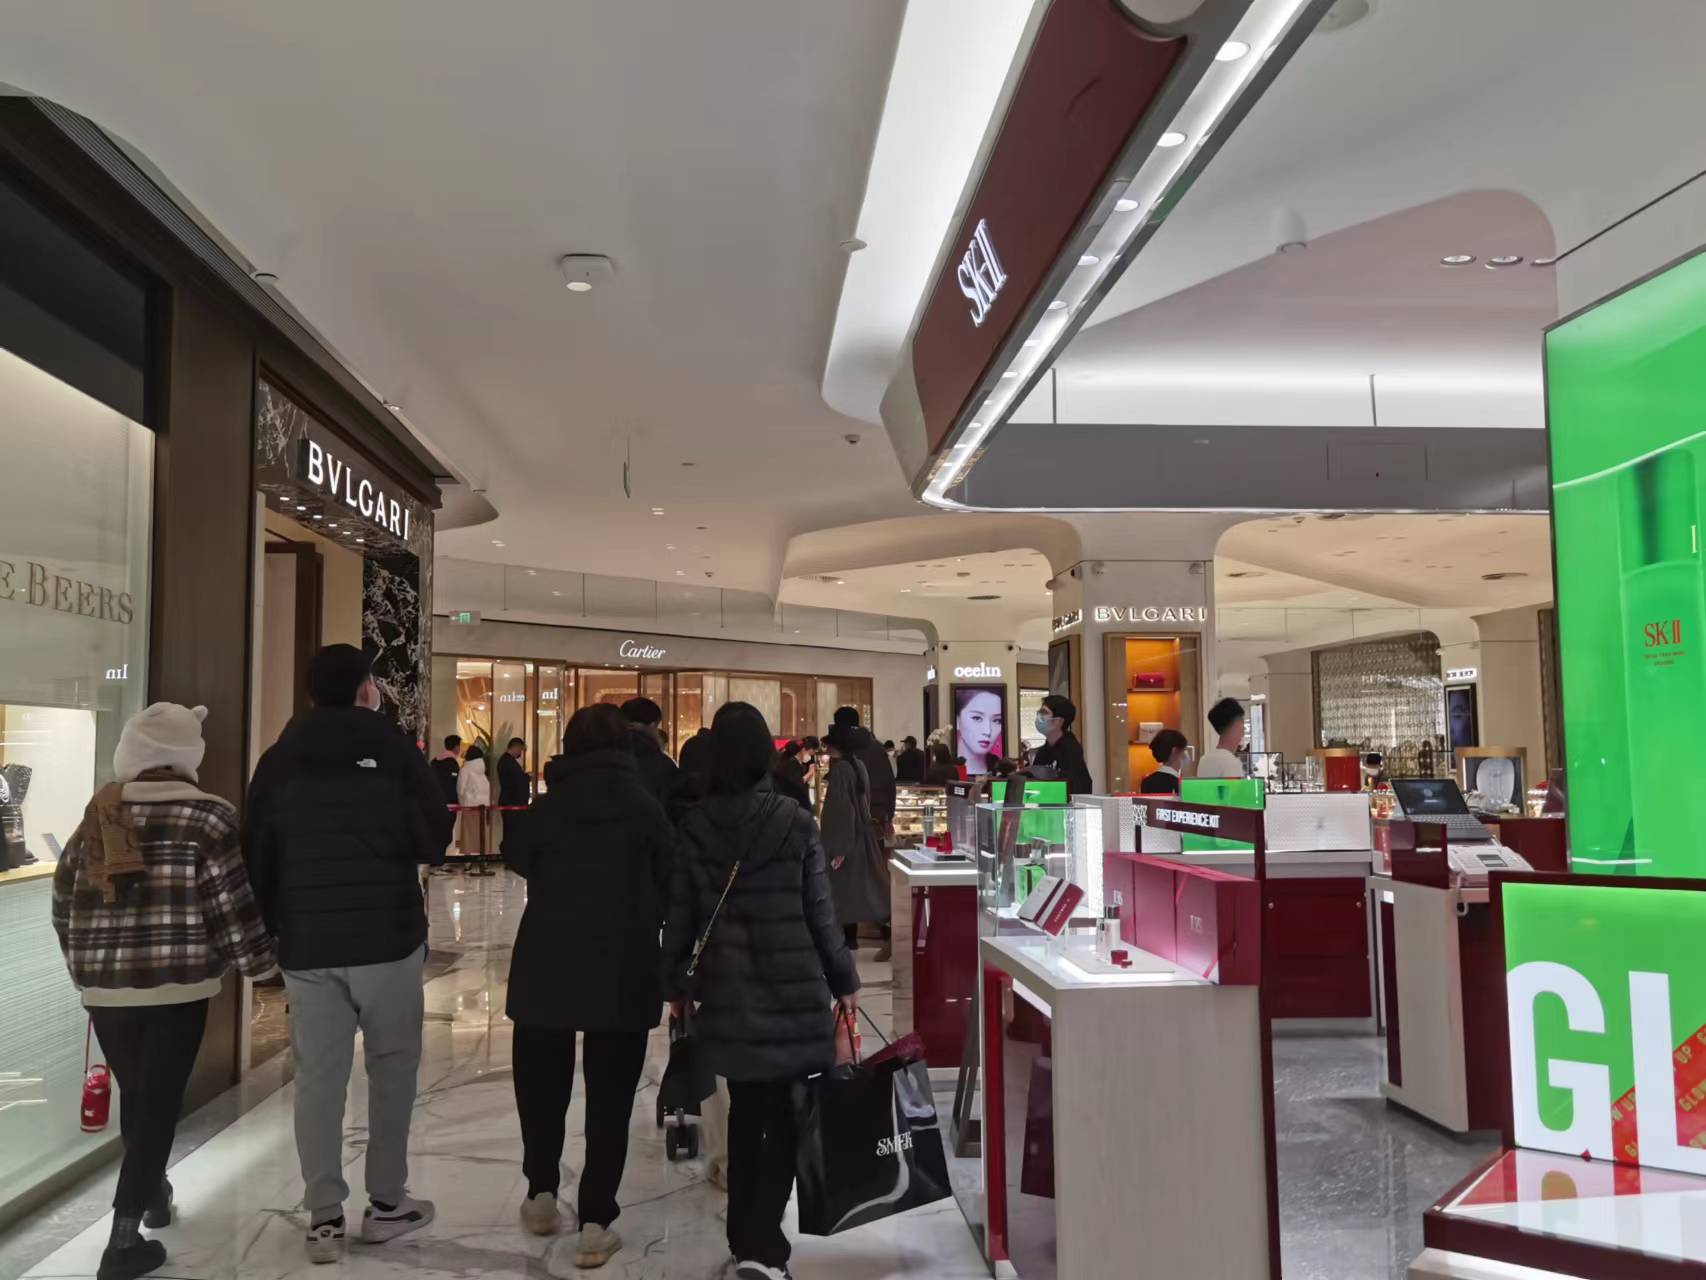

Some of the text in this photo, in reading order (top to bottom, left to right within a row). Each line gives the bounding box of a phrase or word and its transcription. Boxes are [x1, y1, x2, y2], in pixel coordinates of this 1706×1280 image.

[307, 439, 409, 541] BVLGARI
[1095, 606, 1206, 622] BVLGARI
[619, 639, 666, 659] Cartier
[1674, 1045, 1692, 1065] UP
